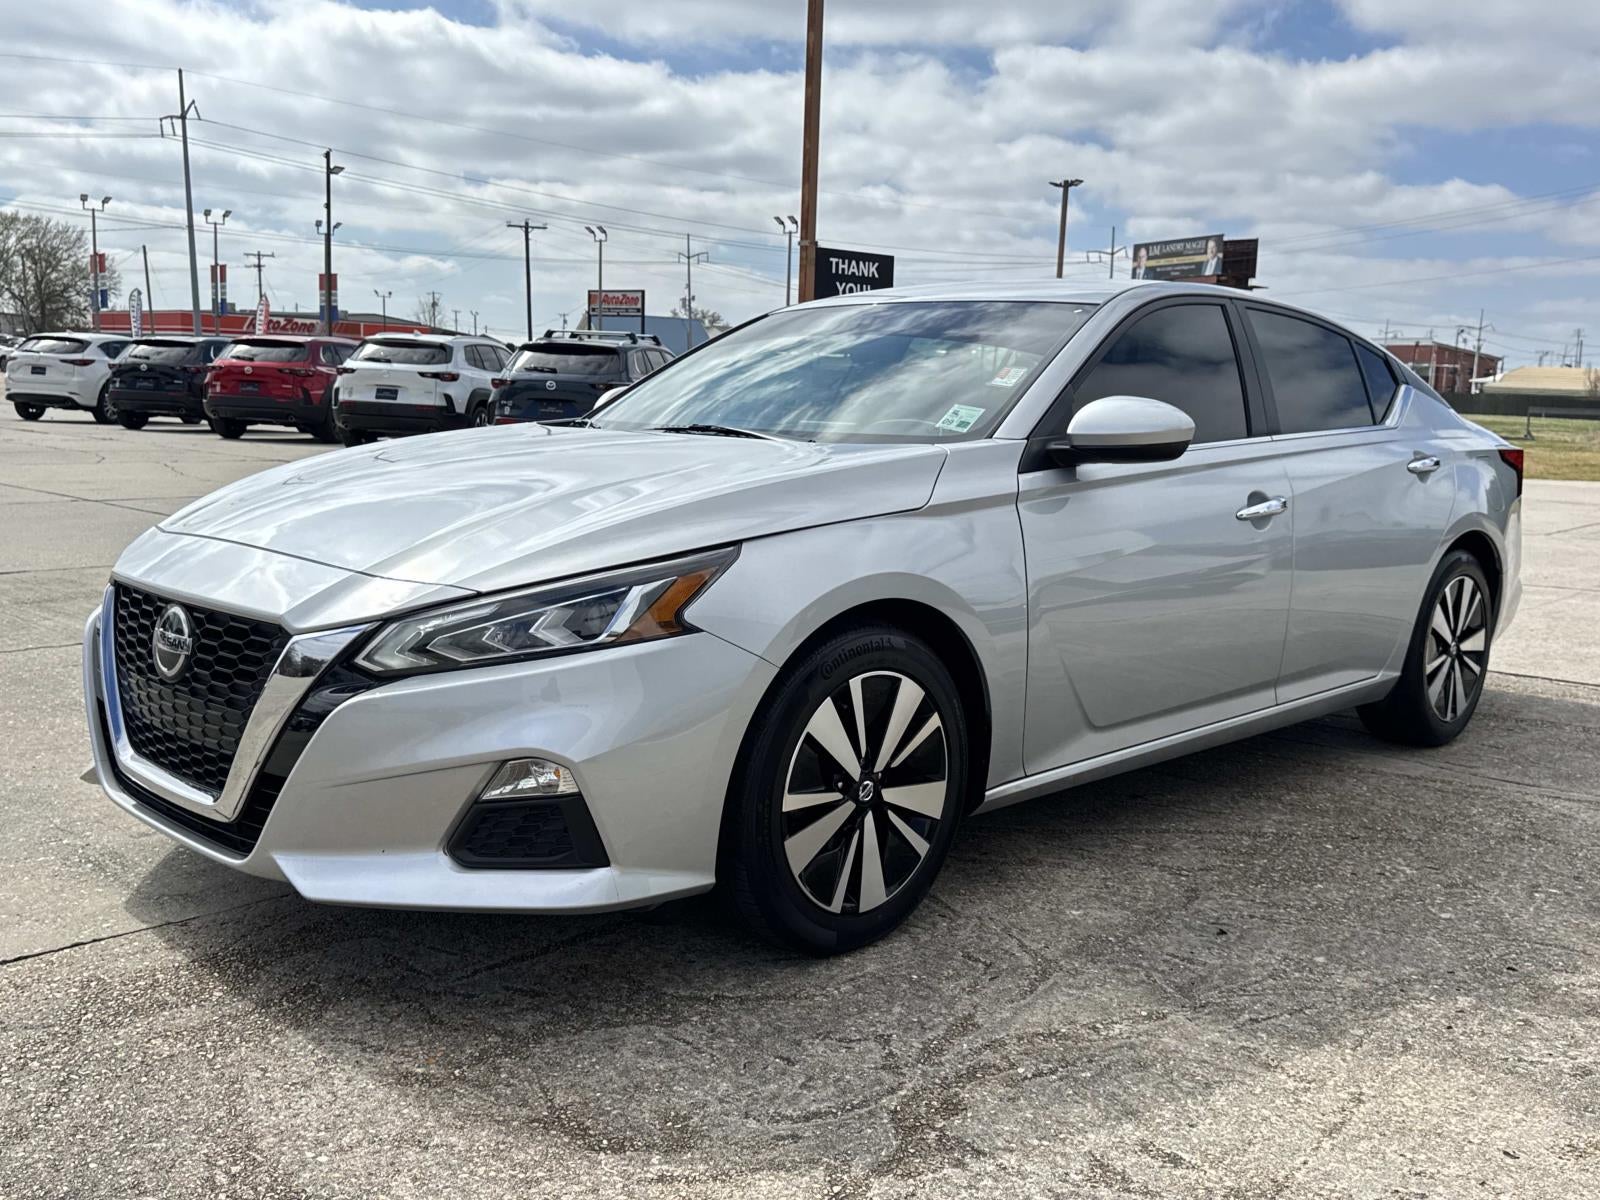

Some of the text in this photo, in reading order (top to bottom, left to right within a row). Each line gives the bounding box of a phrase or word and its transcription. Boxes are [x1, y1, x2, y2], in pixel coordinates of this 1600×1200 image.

[829, 257, 879, 278] THANK
[600, 292, 640, 306] AutoZone
[246, 317, 315, 333] AtoZone
[820, 638, 884, 680] Continental
